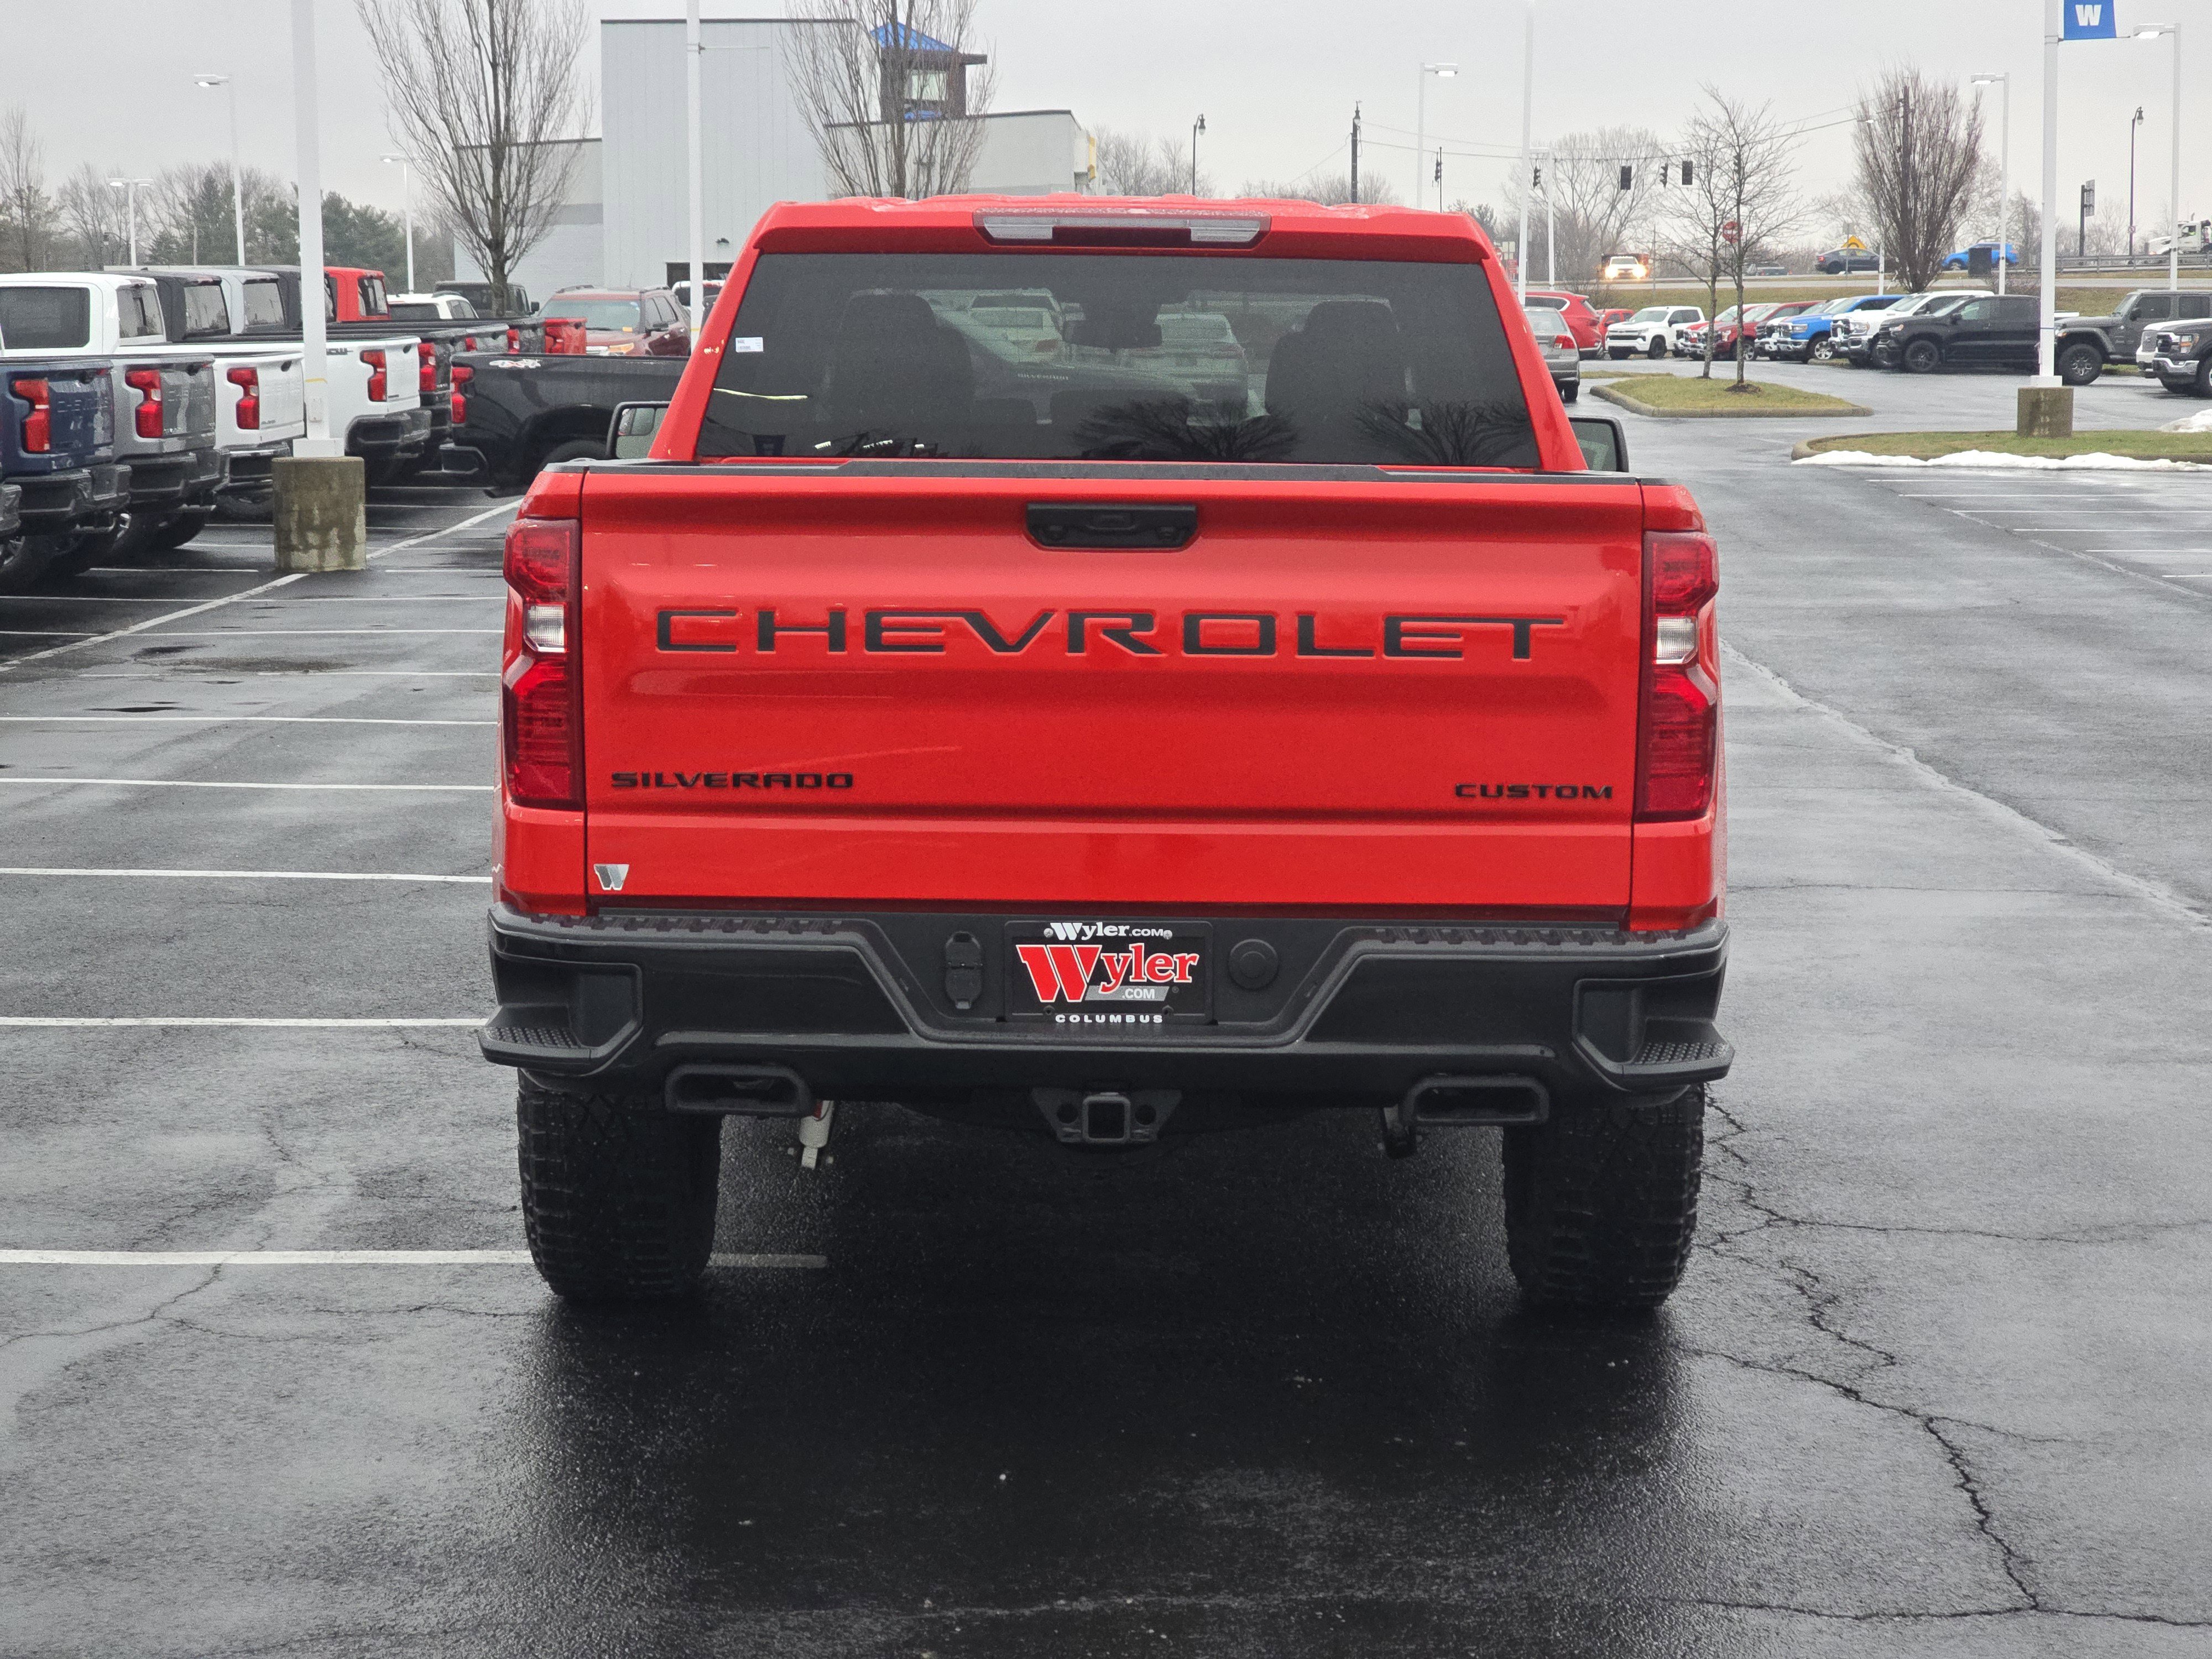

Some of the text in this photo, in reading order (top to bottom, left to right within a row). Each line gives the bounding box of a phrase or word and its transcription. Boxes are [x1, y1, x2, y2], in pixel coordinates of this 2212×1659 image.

[2075, 4, 2102, 26] W
[656, 609, 1566, 659] CHEVROLET
[611, 771, 854, 789] SILVERADO
[1455, 782, 1614, 799] CUSTOM
[593, 863, 630, 891] W
[1015, 943, 1200, 1003] Wyler
[1122, 988, 1155, 1000] .COM
[1055, 1014, 1163, 1024] COLUMBUS
